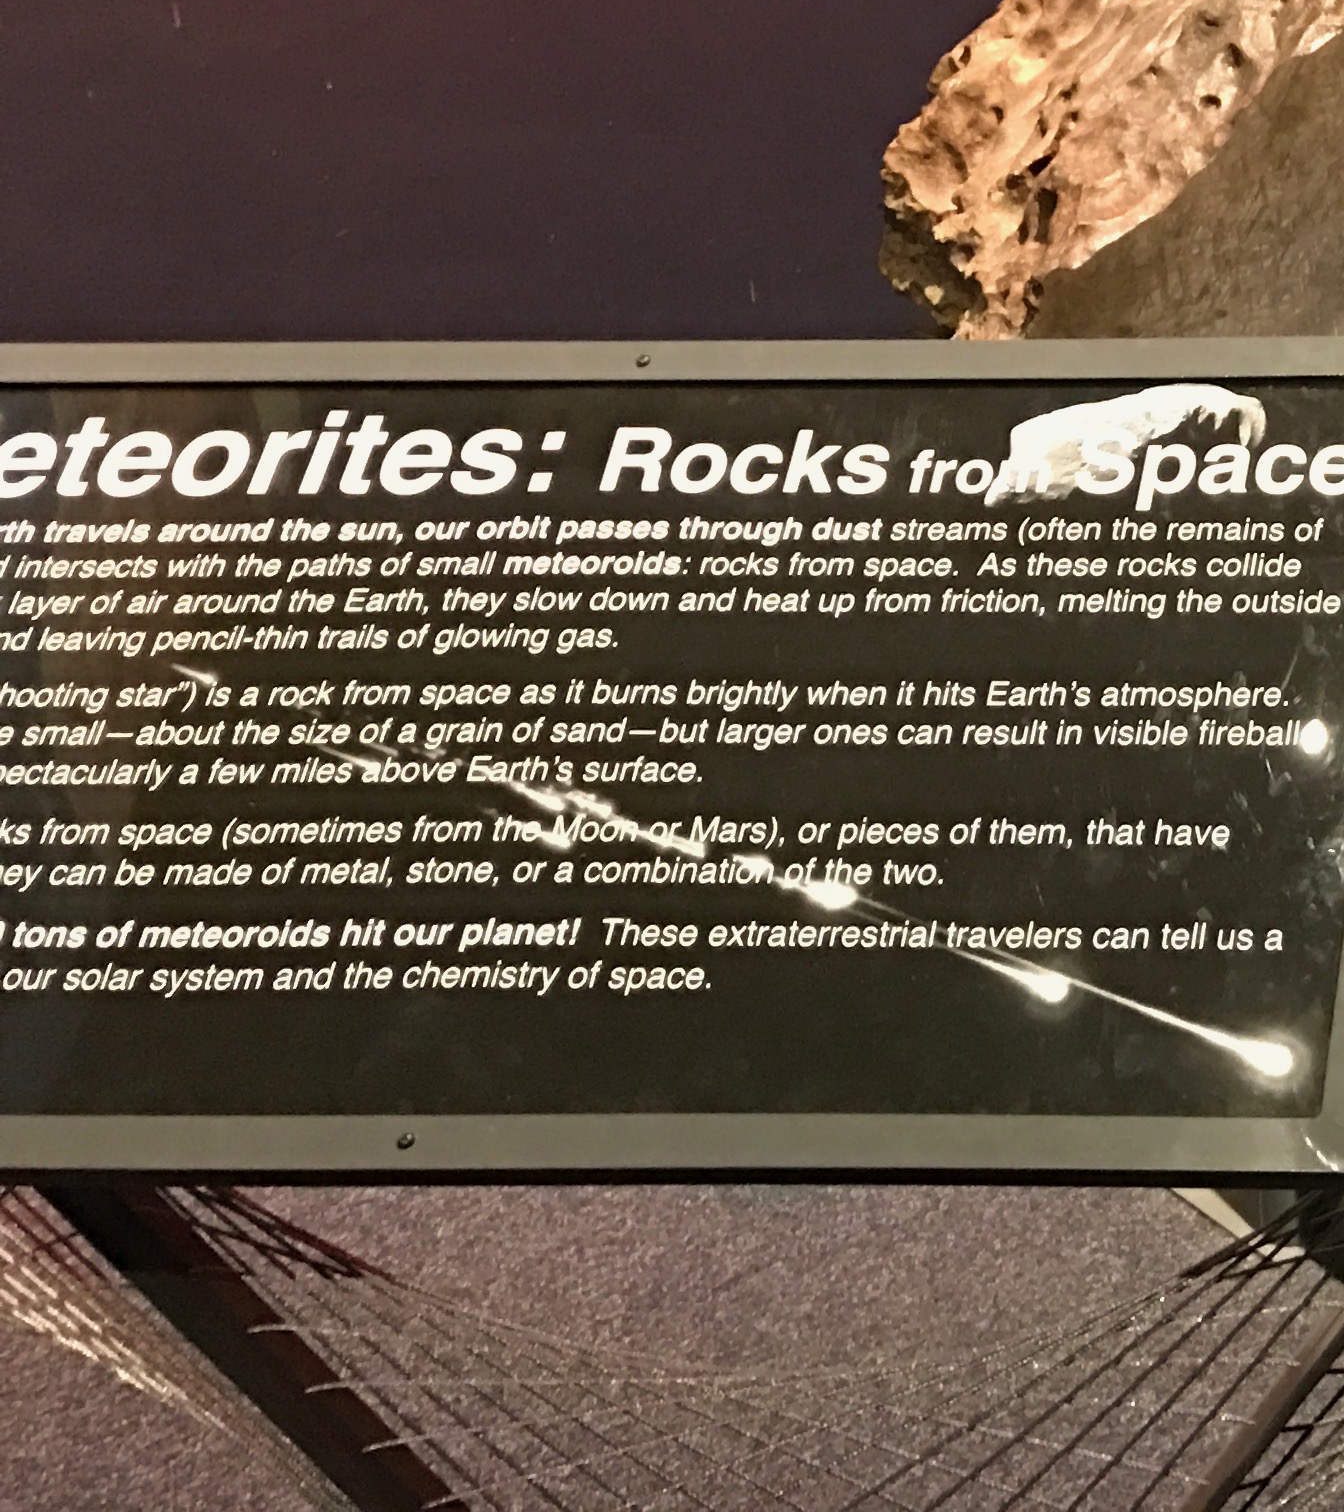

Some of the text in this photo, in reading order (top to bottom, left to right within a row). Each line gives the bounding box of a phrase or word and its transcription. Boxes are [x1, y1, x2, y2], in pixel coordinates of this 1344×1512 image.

[0, 410, 567, 499] eteorites:
[599, 427, 891, 495] Rocks
[909, 449, 1053, 495] from
[43, 514, 1325, 547] travels around the sun, our orbit passes through dust streams (often the remains of
[13, 554, 159, 579] intersects
[167, 553, 227, 578] with
[234, 552, 282, 578] the
[286, 552, 373, 583] paths
[380, 551, 414, 577] of
[416, 550, 498, 577] small
[502, 550, 692, 576] meteoroids:
[699, 551, 780, 577] rocks
[788, 551, 855, 577] from
[863, 557, 959, 583] space.
[976, 552, 1017, 577] As
[1026, 551, 1108, 577] these
[1116, 552, 1197, 577] rocks
[1206, 552, 1302, 578] collide
[7, 586, 1342, 621] layer of air around the Earth, they slow down and heat up from friction, melting the outside
[36, 622, 619, 658] leaving pencil-thin trails of glowing gas.
[204, 682, 232, 708] is
[239, 686, 260, 707] a
[267, 680, 336, 710] rock
[342, 679, 412, 706] from
[419, 684, 512, 711] space
[519, 684, 557, 705] as
[565, 678, 585, 705] it
[591, 678, 678, 706] burns
[686, 678, 799, 713] brightly
[807, 680, 887, 707] when
[896, 680, 916, 706] it
[922, 680, 976, 707] hits
[986, 680, 1091, 707] Earth’s
[1100, 681, 1289, 713] atmosphere.
[231, 718, 281, 746] the
[287, 717, 351, 745] size
[359, 717, 393, 745] of
[396, 723, 417, 745] a
[423, 716, 504, 750] grain
[511, 716, 546, 743] of
[716, 717, 807, 751] larger
[813, 723, 889, 745] ones
[897, 724, 953, 745] can
[962, 718, 1049, 746] result
[1056, 719, 1083, 746] in
[1093, 718, 1189, 747] visible
[1198, 718, 1323, 747] fireball
[178, 763, 199, 785] a
[207, 757, 266, 785] few
[270, 757, 353, 785] miles
[360, 755, 458, 784] above
[465, 754, 574, 784] Earth’s
[581, 755, 703, 785] surface.
[39, 814, 1231, 852] from space (sometimes from the Moon or Mars), or pieces of them, that have
[12, 921, 88, 949] tons
[95, 919, 136, 949] of
[138, 918, 331, 949] meteoroids
[339, 918, 387, 947] hit
[393, 923, 455, 947] our
[457, 917, 582, 953] planet!
[602, 917, 699, 947] These
[708, 919, 938, 948] extraterrestrial
[946, 920, 1083, 950] travelers
[1092, 927, 1150, 950] can
[1161, 921, 1207, 951] tell
[1216, 928, 1254, 951] us
[1264, 928, 1283, 952] a
[2, 959, 711, 999] our solar system and the chemistry of space.
